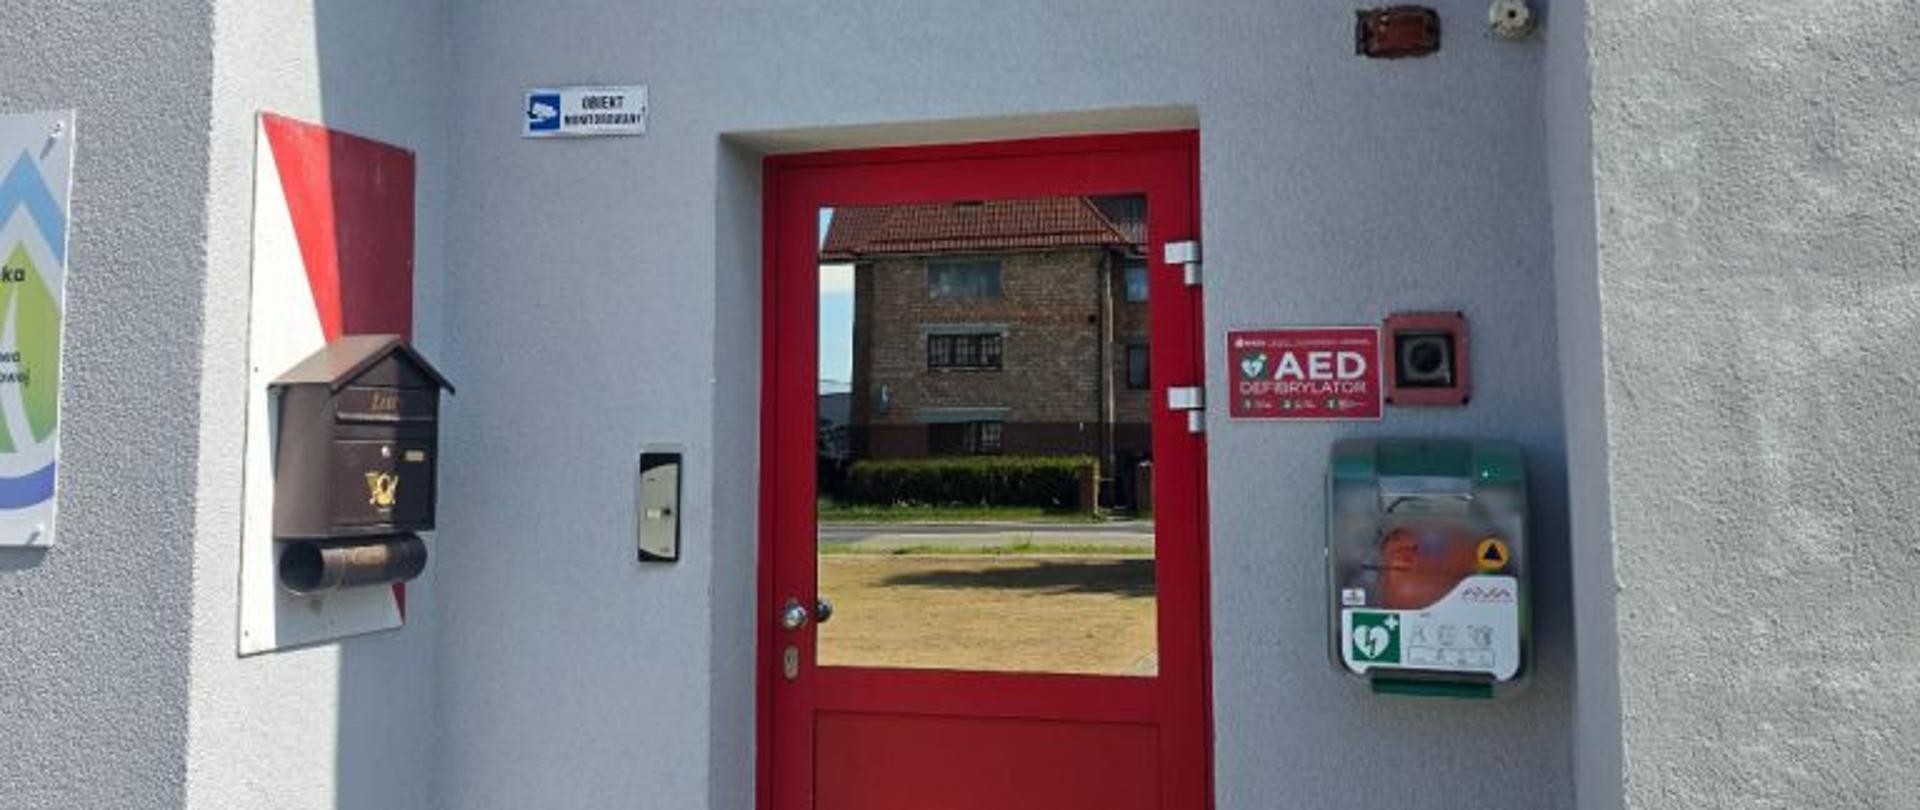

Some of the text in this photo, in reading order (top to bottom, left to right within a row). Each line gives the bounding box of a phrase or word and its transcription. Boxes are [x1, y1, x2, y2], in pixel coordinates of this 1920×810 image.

[582, 95, 625, 110] OBIEKT
[1274, 350, 1367, 381] AED
[1239, 381, 1367, 395] DEFIBRYLATOR
